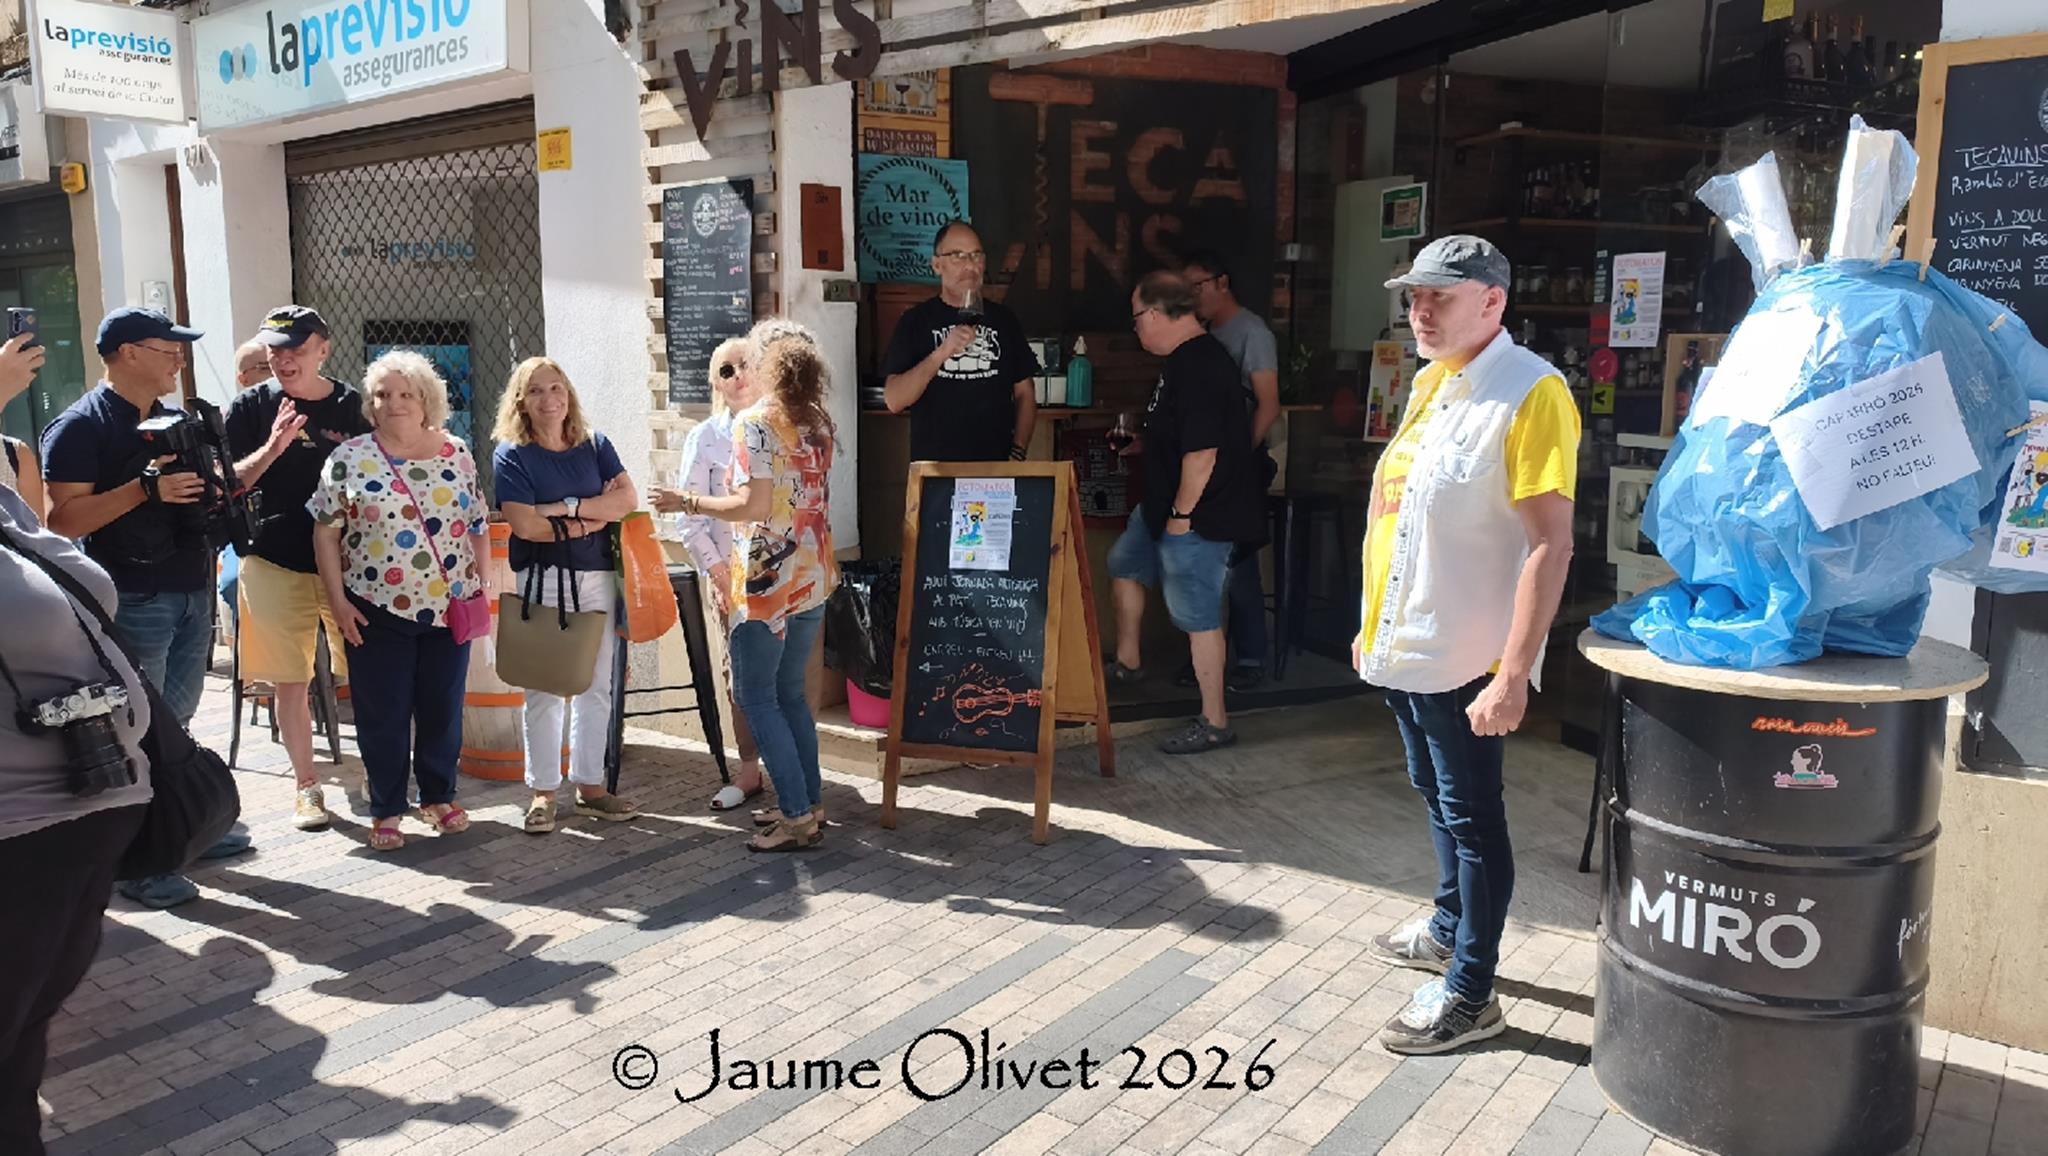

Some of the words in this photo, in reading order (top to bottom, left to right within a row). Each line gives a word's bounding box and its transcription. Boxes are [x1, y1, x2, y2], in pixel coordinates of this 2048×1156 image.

[44, 18, 172, 55] laprevisió
[99, 49, 173, 66] assegurances
[343, 36, 468, 88] assegurances
[64, 68, 89, 81] Més
[53, 82, 66, 93] al
[68, 84, 105, 98] servei
[988, 73, 1246, 207] TECA
[885, 183, 930, 204] Mar
[867, 206, 895, 227] de
[899, 206, 949, 227] vino
[1949, 233, 2012, 249] VERMUT
[1888, 382, 1924, 405] 2026
[1846, 412, 1912, 446] DESTAPE
[1856, 474, 1881, 491] NO
[1664, 870, 1776, 907] VERMUTS
[1629, 875, 1822, 970] MIRÓ
